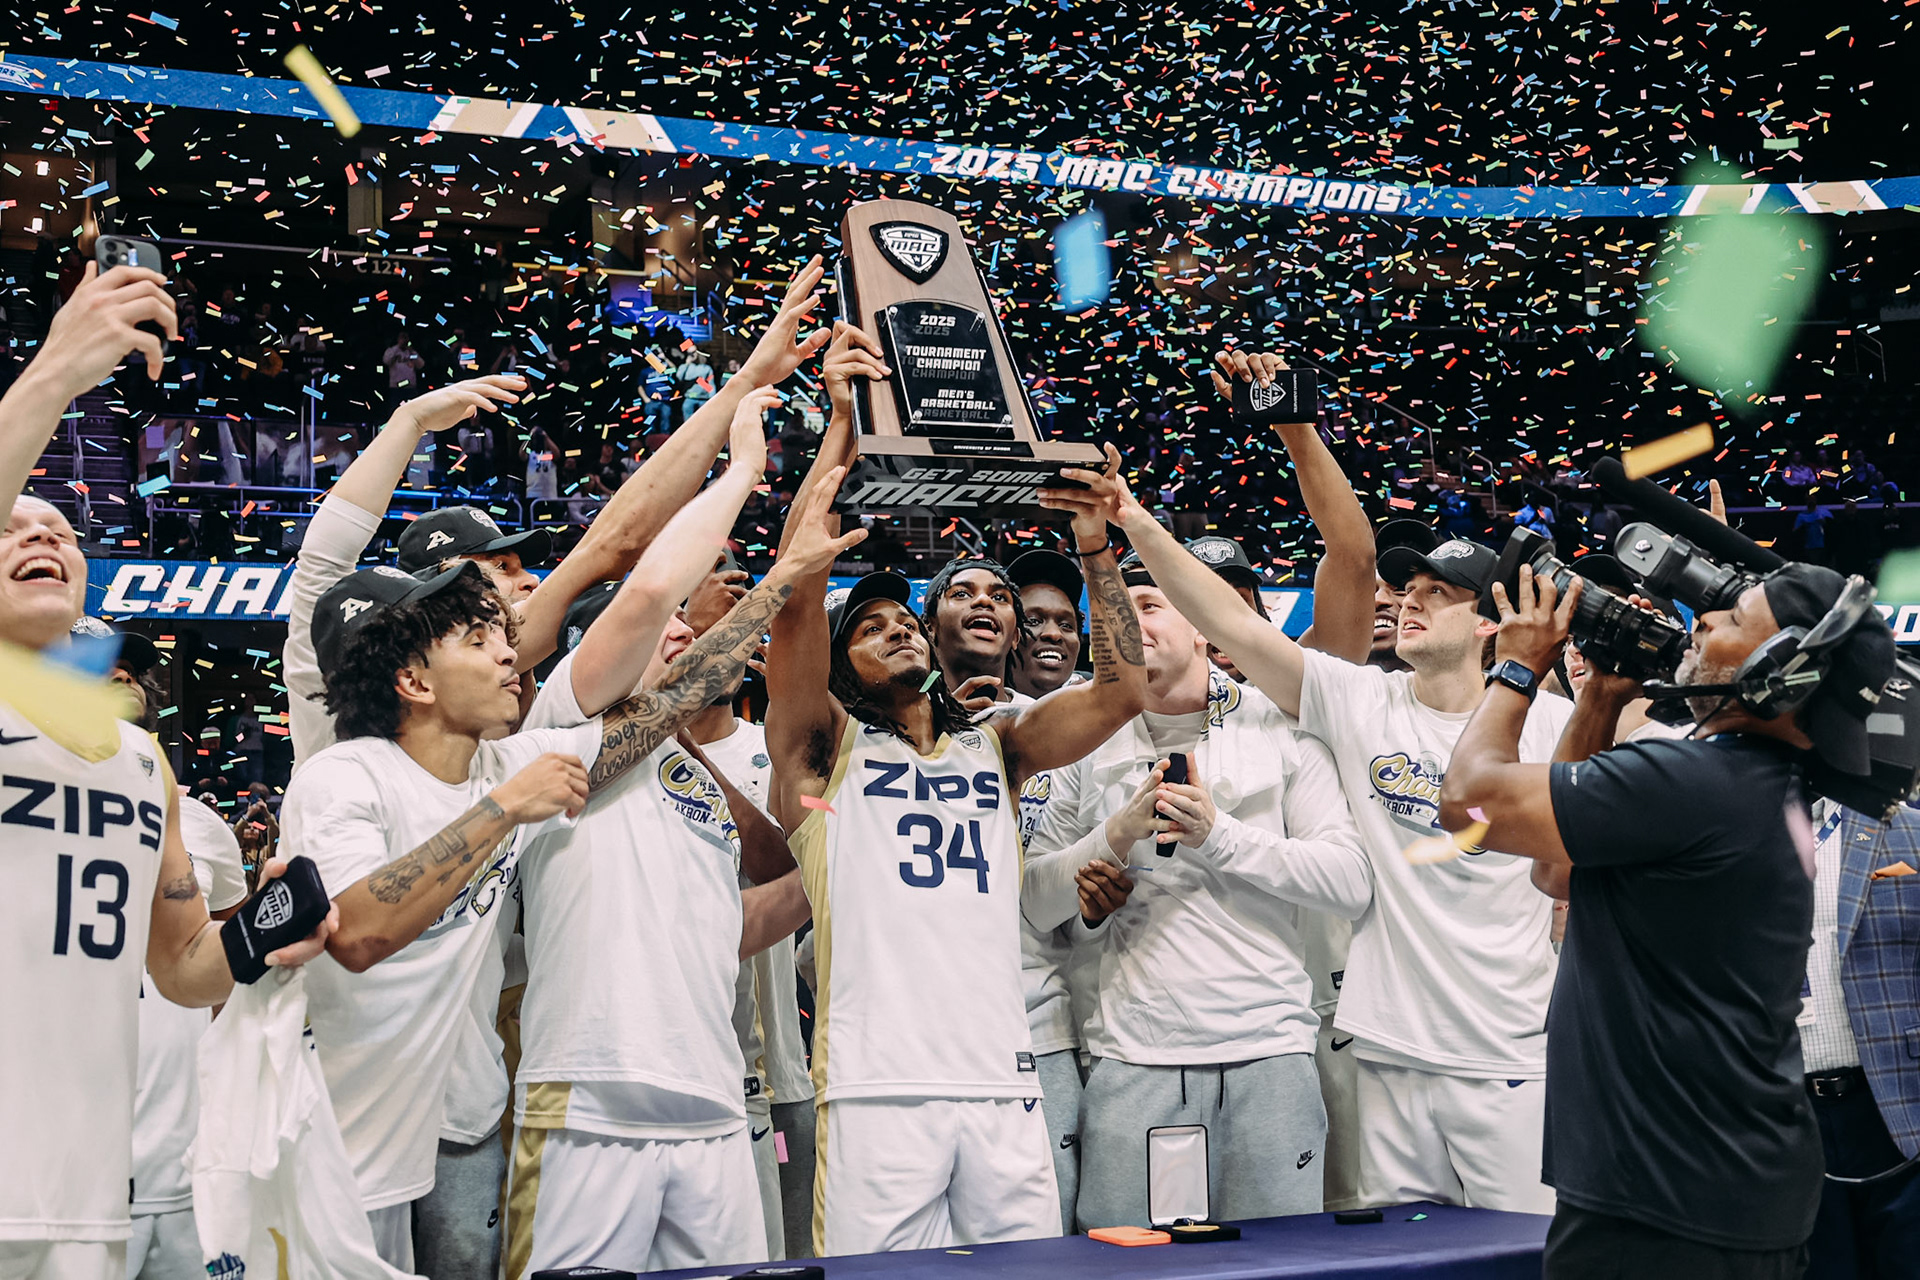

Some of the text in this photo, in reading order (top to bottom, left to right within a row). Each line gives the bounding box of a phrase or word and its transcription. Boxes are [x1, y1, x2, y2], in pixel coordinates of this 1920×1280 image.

[930, 145, 1402, 213] 2025 MAC CHAMPIONS
[890, 239, 939, 253] MAC
[919, 314, 957, 327] 2025
[905, 345, 987, 360] TOURNAMENT
[915, 357, 981, 371] CHAMPION
[920, 397, 996, 411] BASKETBALL
[938, 389, 975, 400] MEN'S
[901, 468, 1055, 484] GET SOME
[425, 530, 456, 551] A
[339, 596, 374, 624] A
[863, 759, 999, 810] ZIPS
[1, 775, 163, 852] ZIPS
[675, 802, 711, 824] AKRON
[896, 812, 990, 894] 34
[53, 853, 129, 960] 13
